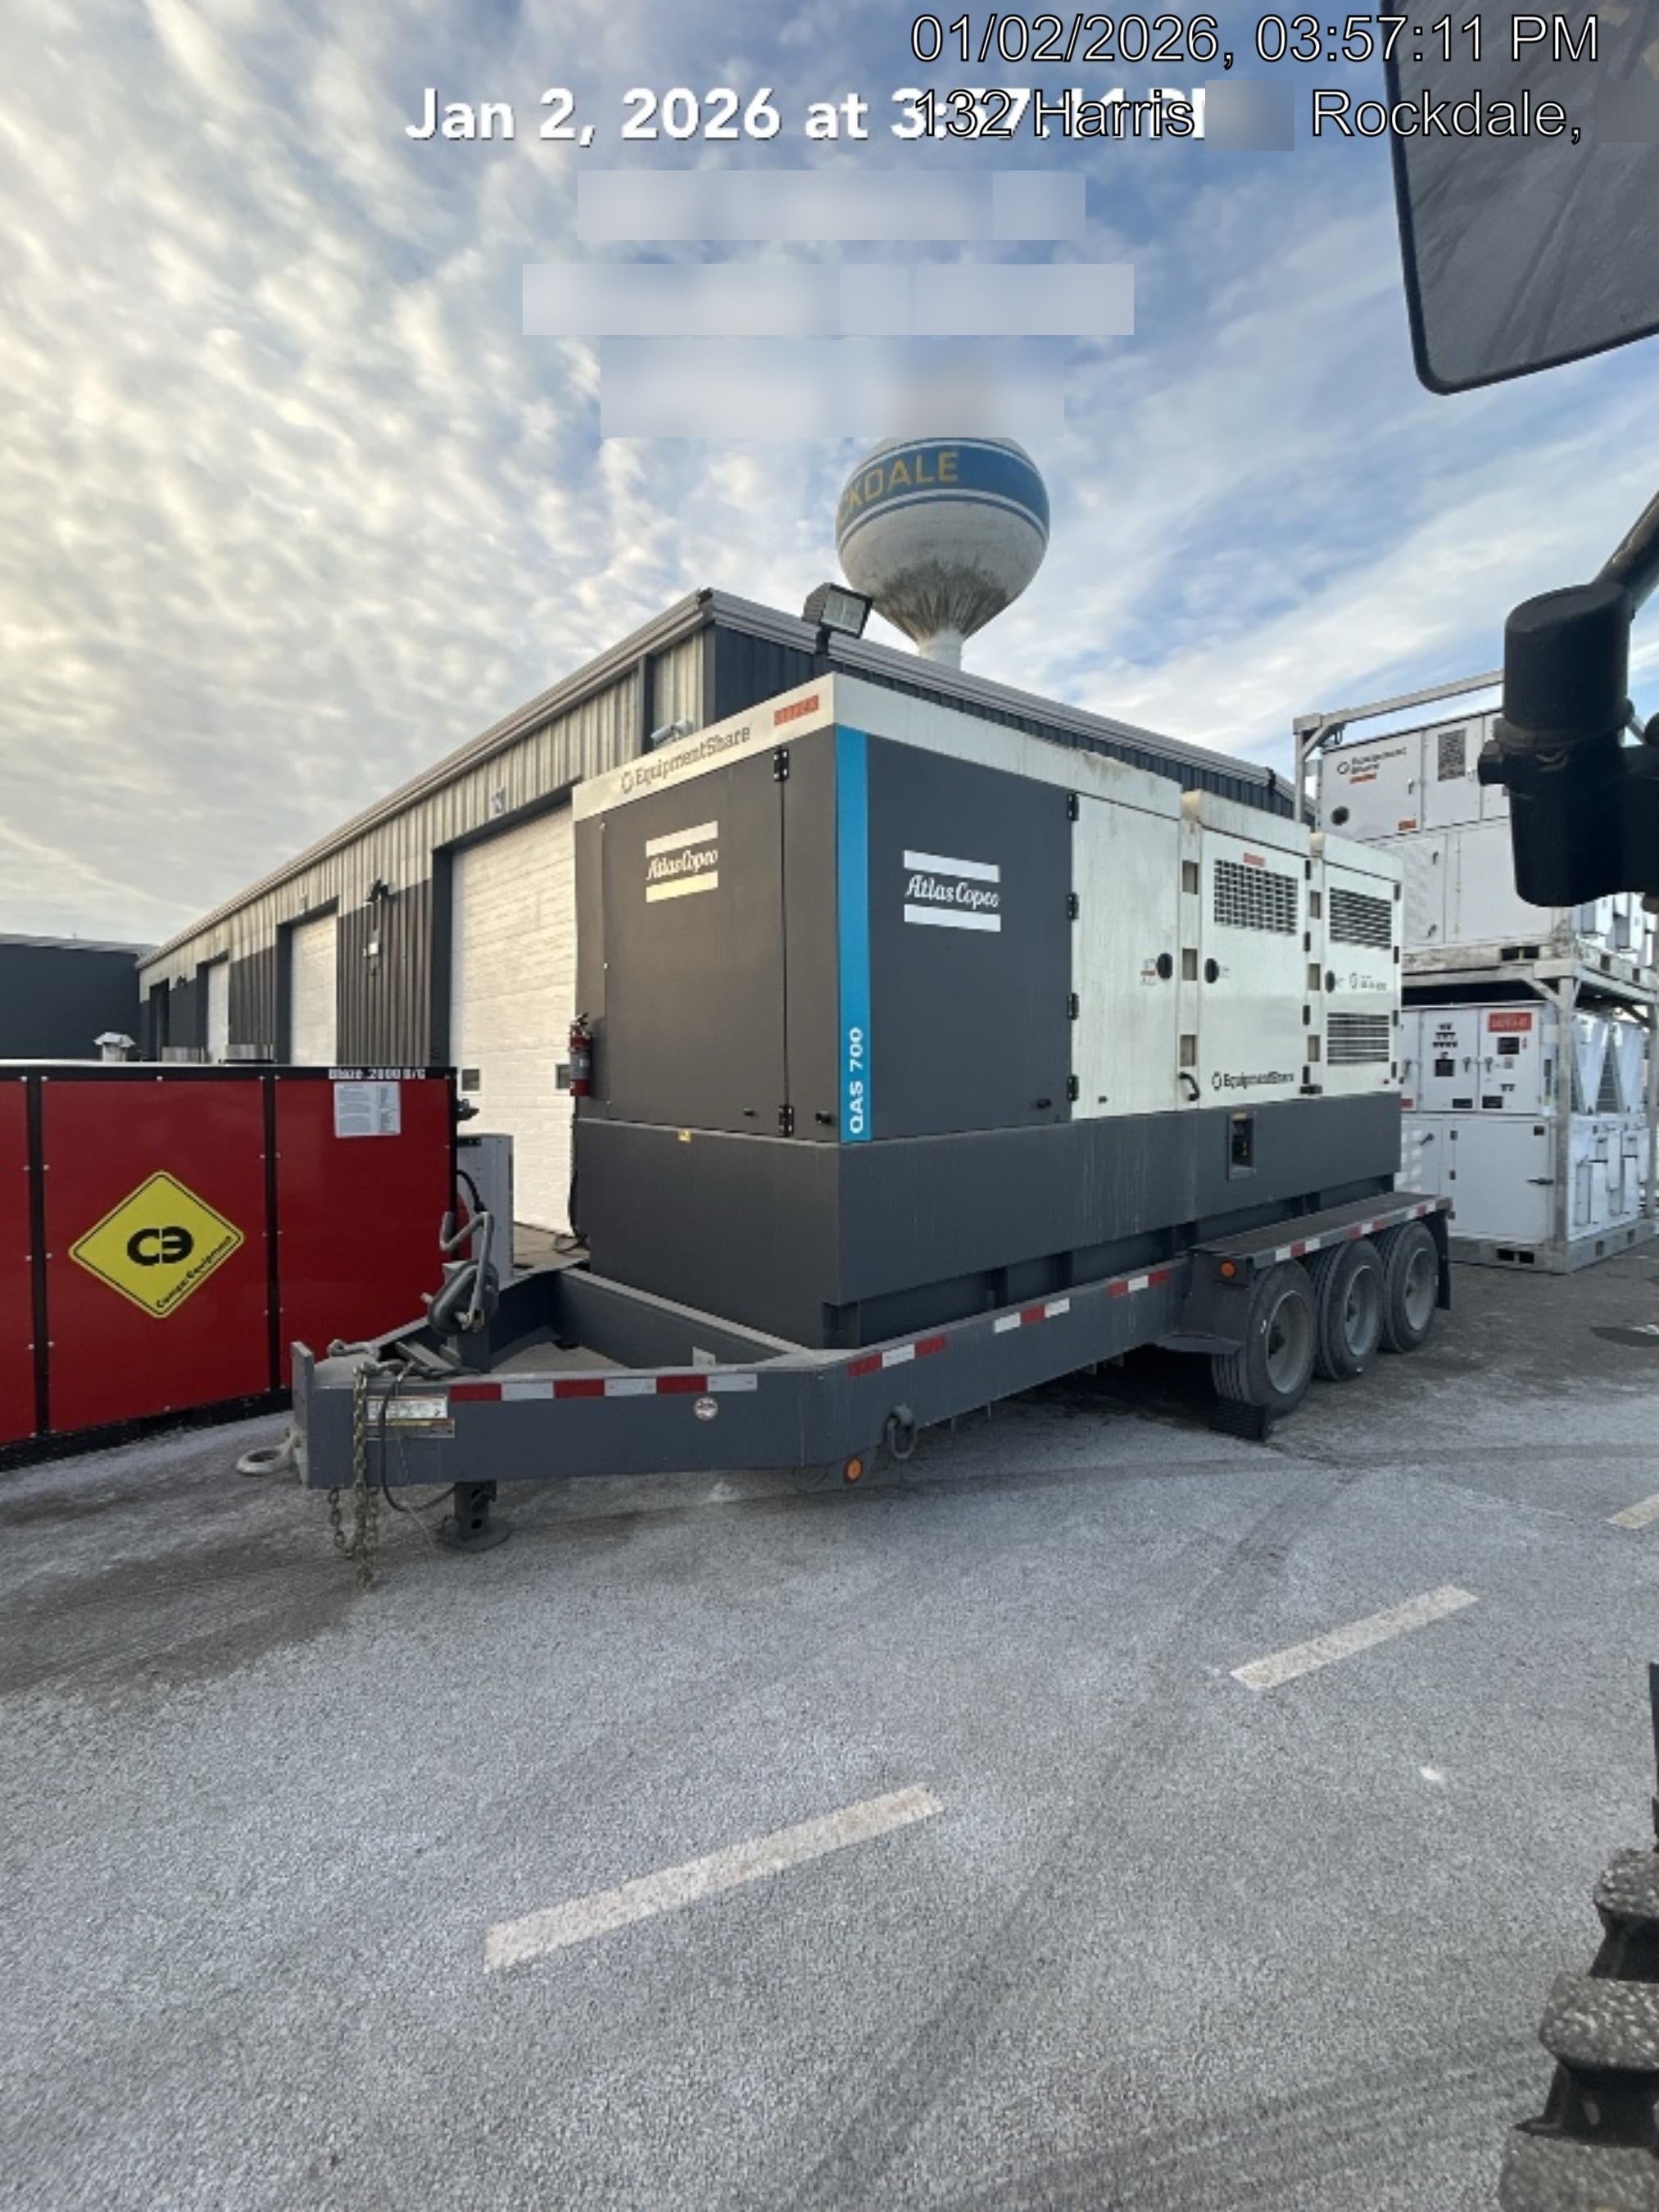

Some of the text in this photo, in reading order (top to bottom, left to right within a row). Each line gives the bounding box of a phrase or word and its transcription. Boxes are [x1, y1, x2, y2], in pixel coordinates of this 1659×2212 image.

[646, 857, 682, 881] Atlas
[904, 874, 1000, 910] Atlas Copco
[850, 1027, 863, 1134] QAS 700
